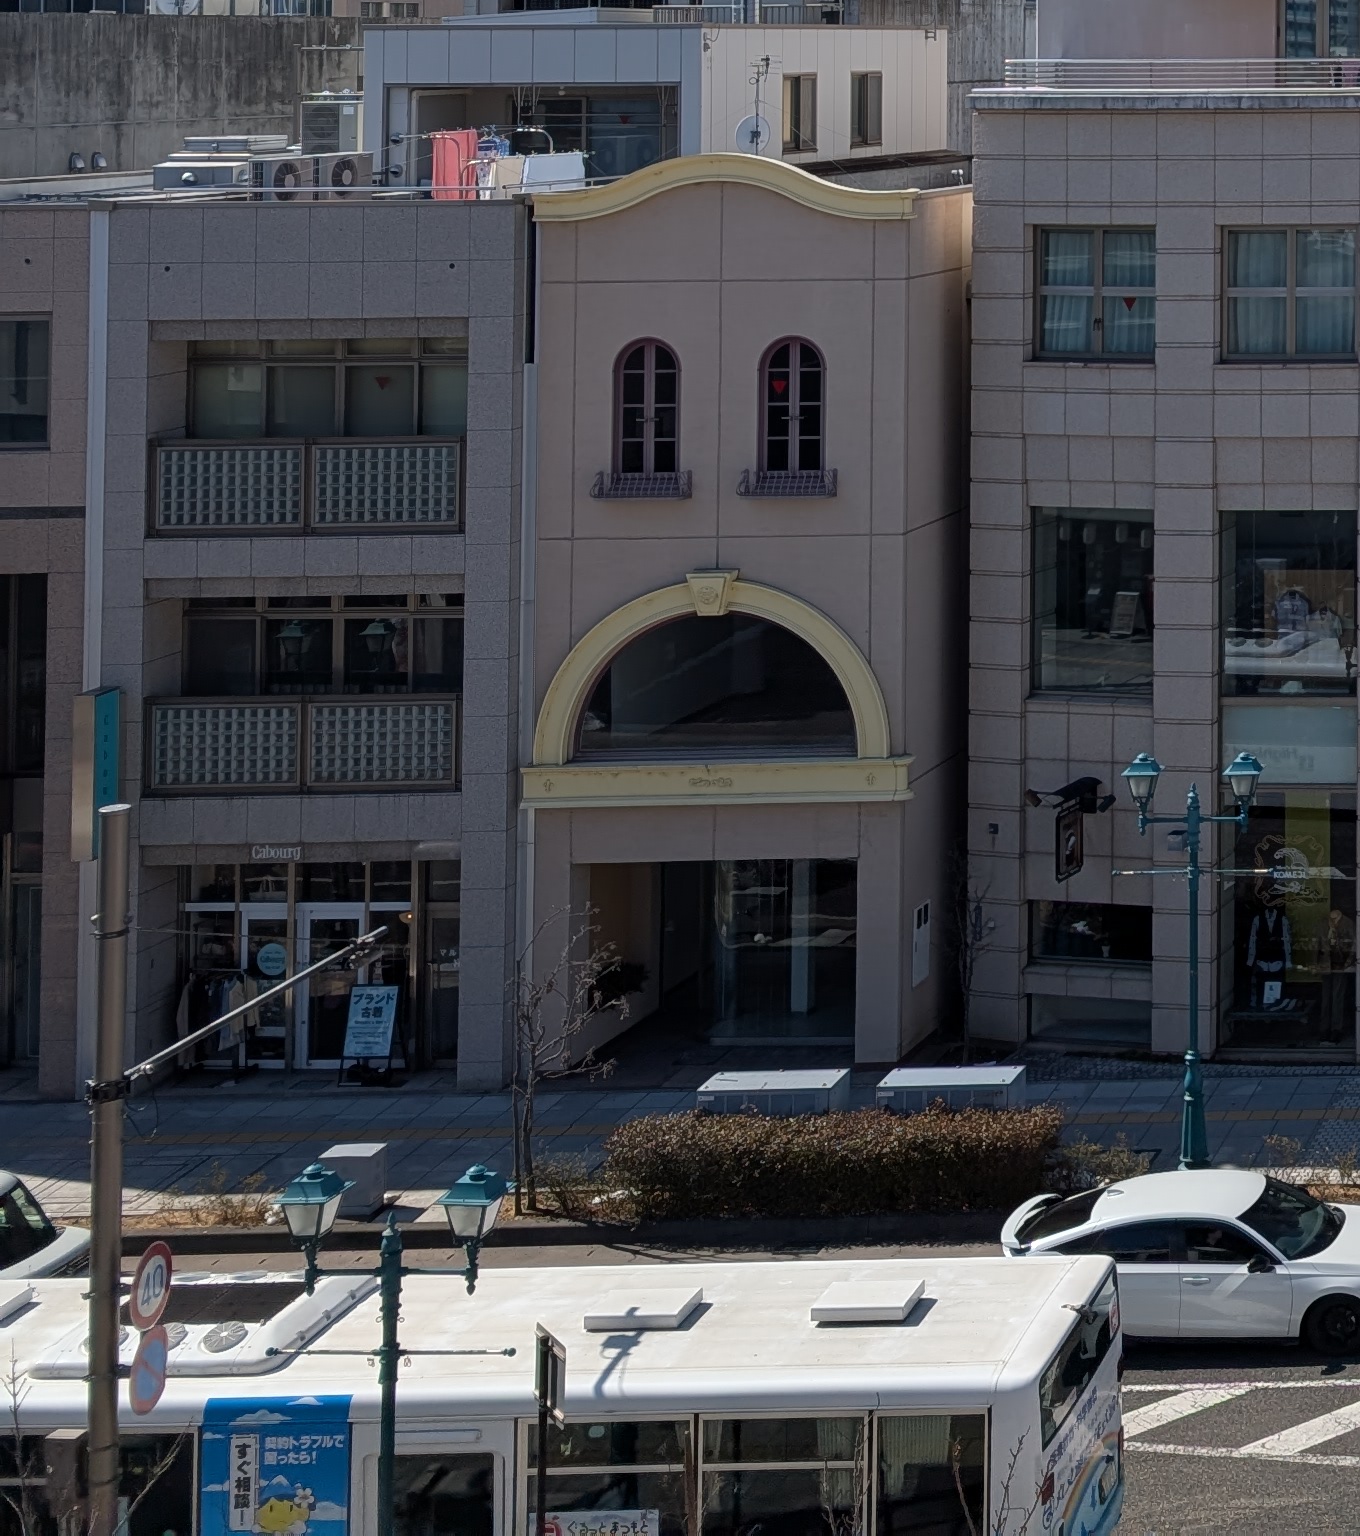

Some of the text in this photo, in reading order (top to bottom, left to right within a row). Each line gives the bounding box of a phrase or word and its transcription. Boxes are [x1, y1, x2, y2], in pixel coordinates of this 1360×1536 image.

[252, 845, 302, 861] Cabourg
[353, 993, 395, 1005] ブランド
[141, 1264, 164, 1306] 40
